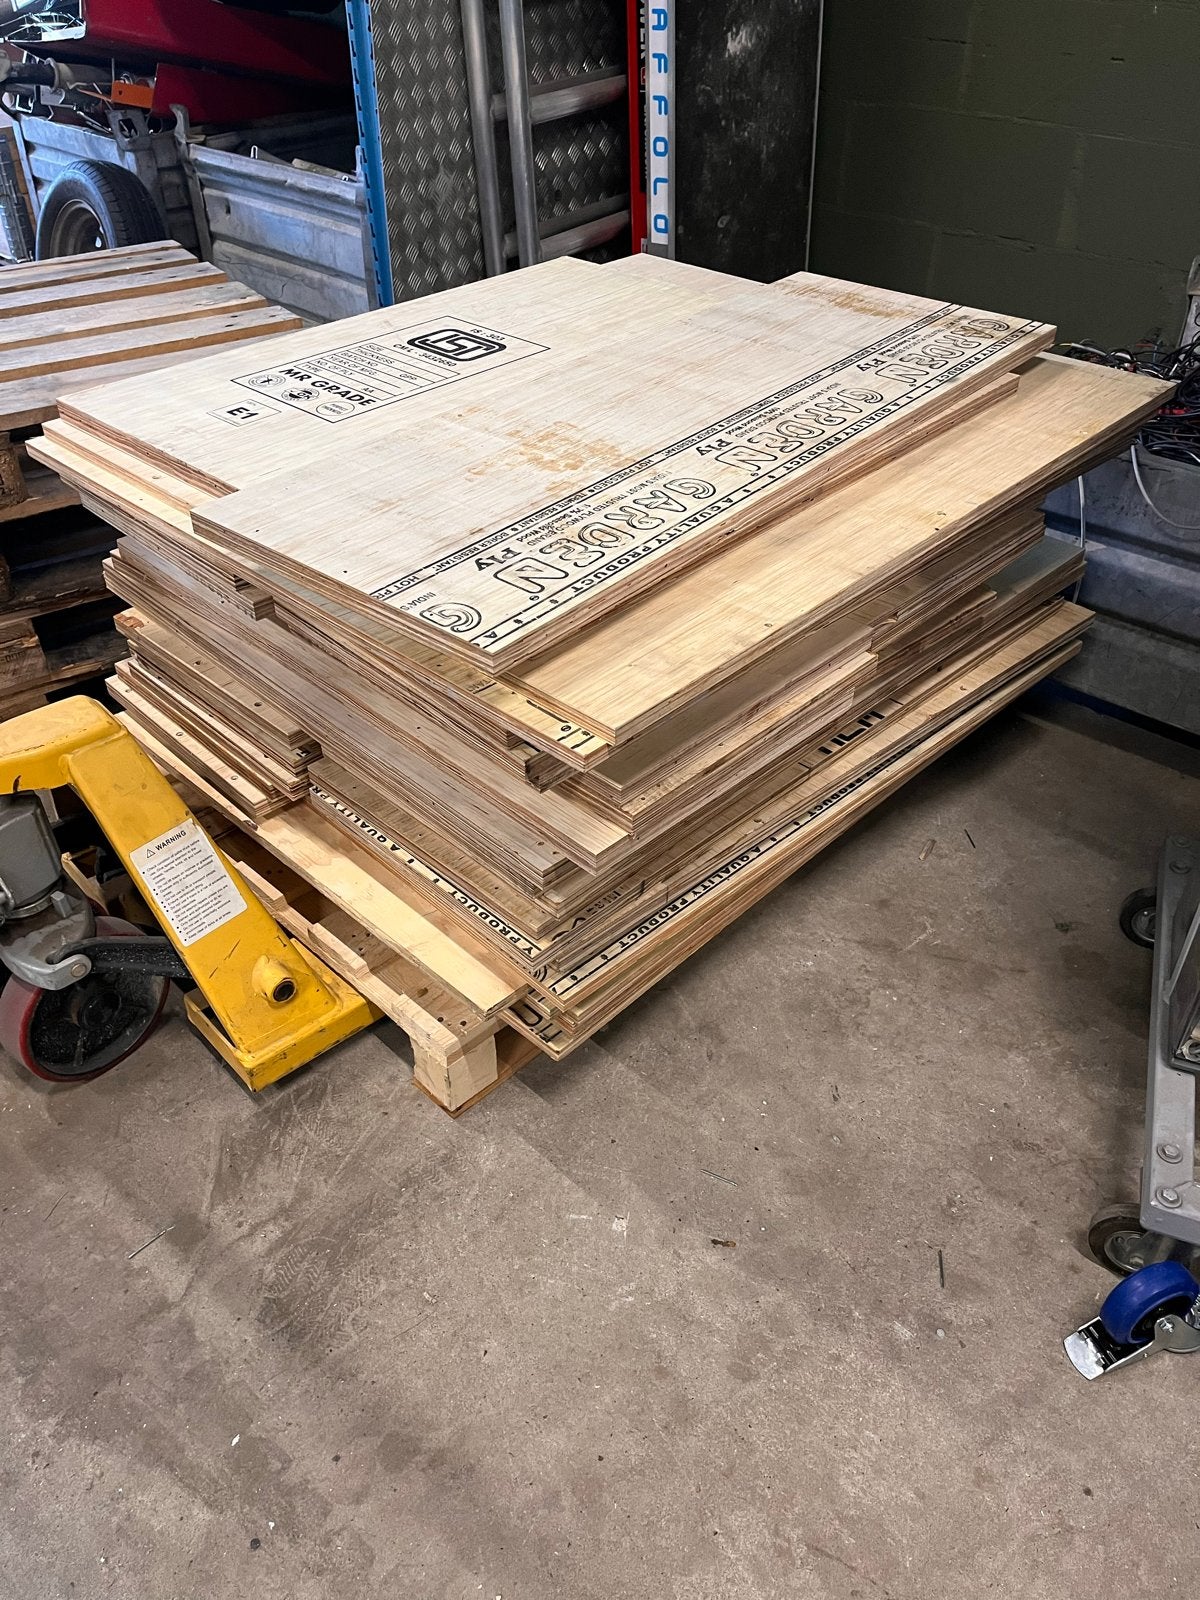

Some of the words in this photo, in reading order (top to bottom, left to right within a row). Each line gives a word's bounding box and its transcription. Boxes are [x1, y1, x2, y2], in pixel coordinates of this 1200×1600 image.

[874, 318, 1011, 386] GARDEN
[981, 334, 1020, 356] QUALITY
[856, 358, 888, 372] Ply
[935, 357, 981, 383] PRODUCT
[279, 369, 312, 381] MR
[311, 381, 376, 406] GRADE
[227, 407, 259, 419] E1
[843, 408, 892, 436] QUALITY
[714, 388, 884, 474] GARDEN
[696, 438, 733, 456] Ply
[783, 437, 842, 471] PRODUCT
[635, 459, 654, 470] HOT
[593, 469, 635, 490] PRESSED
[493, 478, 716, 597] GARDEN
[475, 547, 522, 571] Ply
[571, 545, 652, 593] PRODUCT
[394, 575, 420, 591] HOT
[330, 801, 387, 843] QUALITY
[155, 830, 186, 851] WARNING
[750, 846, 761, 855] A
[691, 855, 751, 899] QUALITY
[448, 889, 518, 944] PRODUCT
[618, 897, 689, 950] PRODUCT
